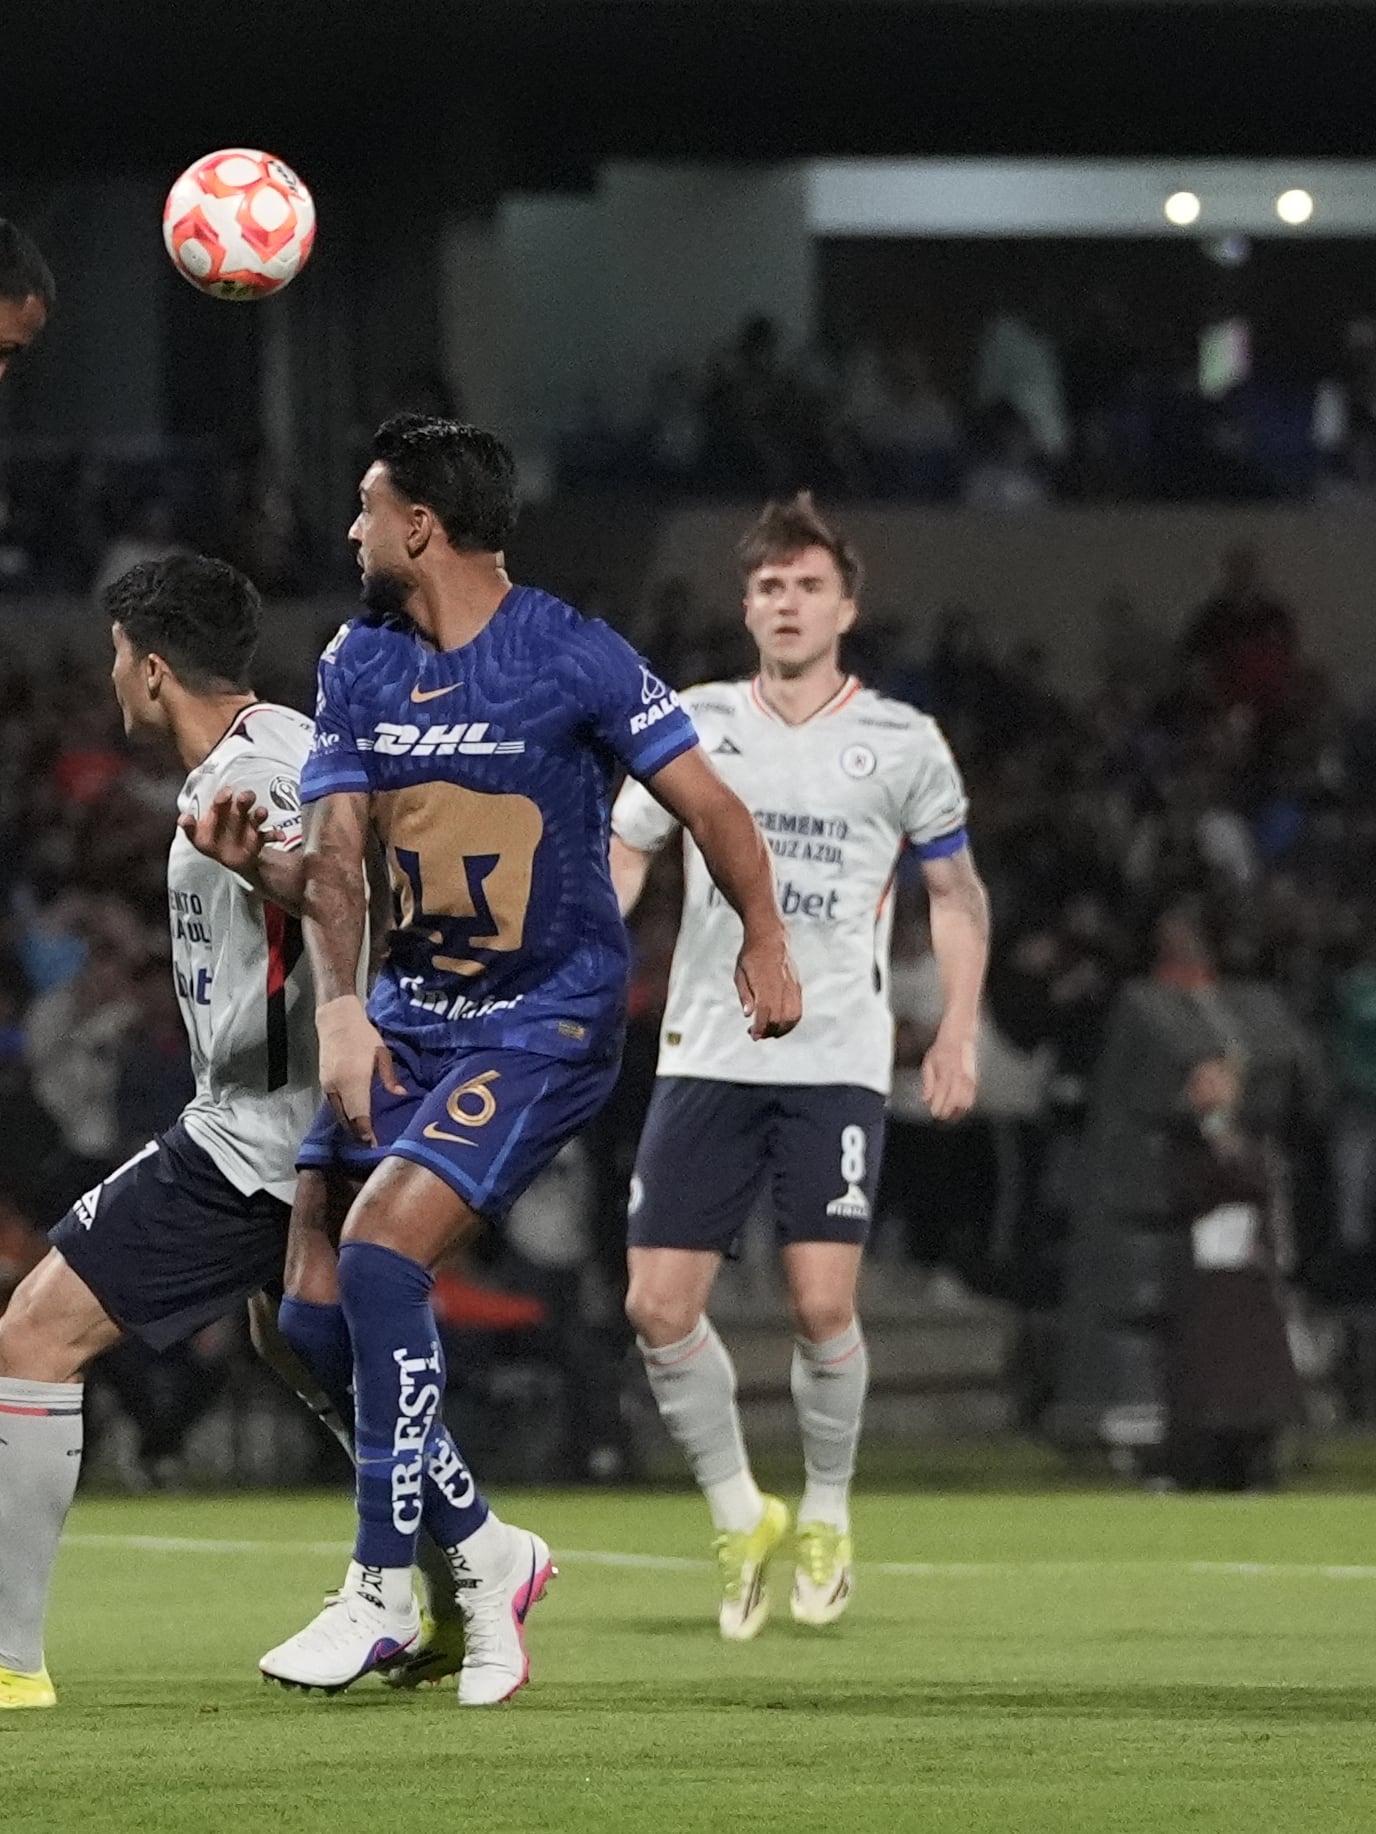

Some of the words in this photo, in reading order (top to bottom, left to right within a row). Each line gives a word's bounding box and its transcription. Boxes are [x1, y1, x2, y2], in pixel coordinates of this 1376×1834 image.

[373, 722, 498, 756] DHL
[446, 1069, 501, 1127] 6
[841, 1124, 866, 1184] 8
[392, 1347, 442, 1536] CREST
